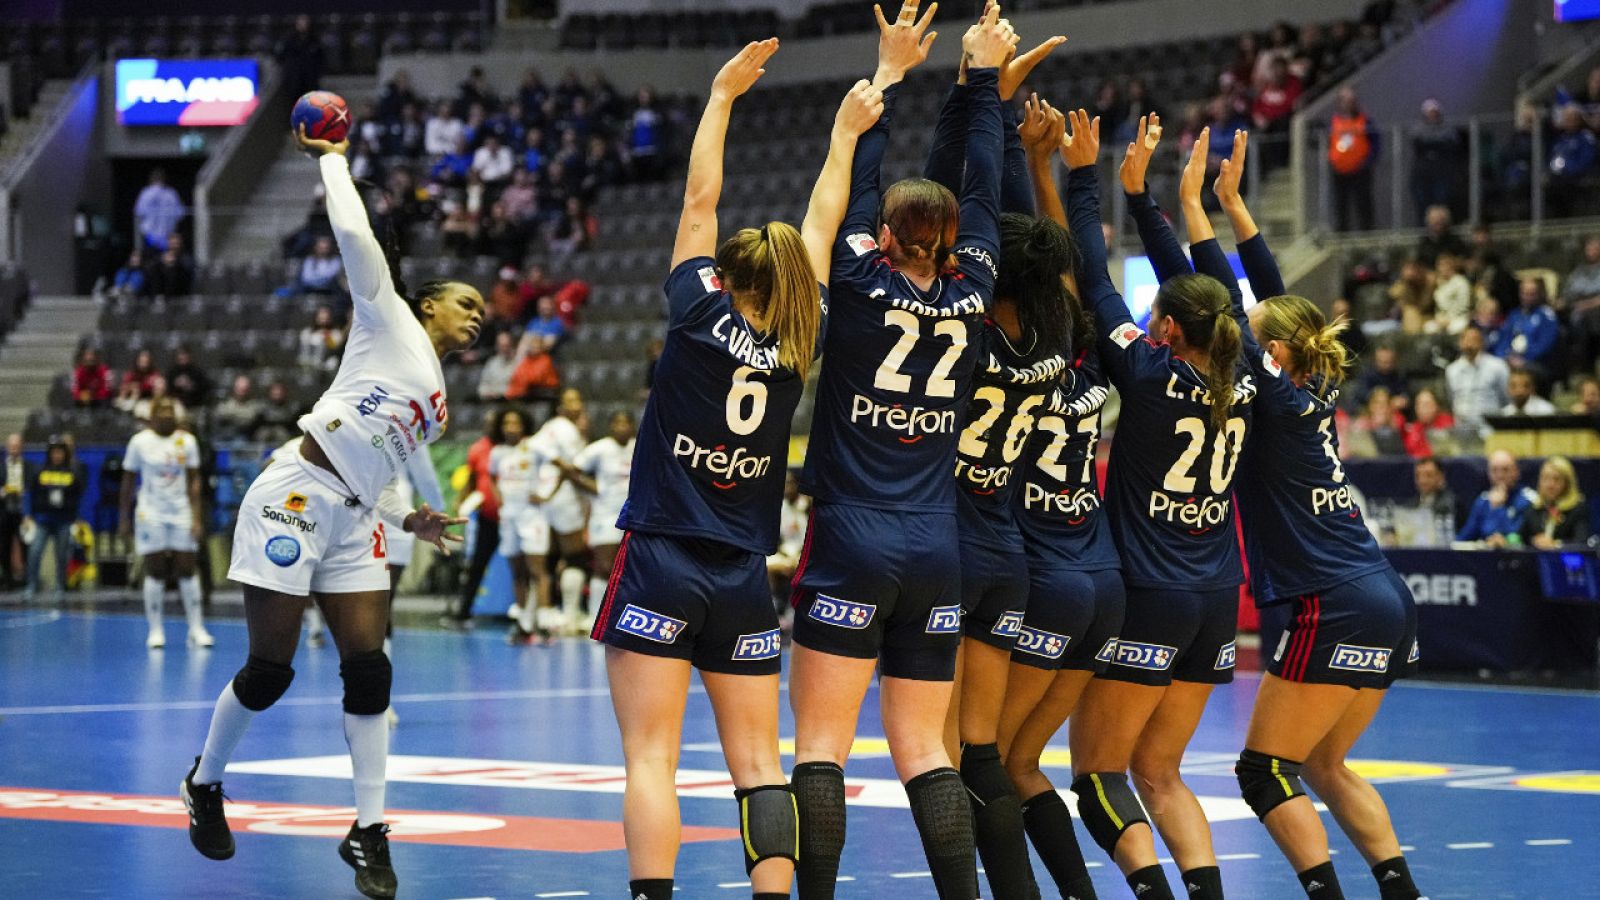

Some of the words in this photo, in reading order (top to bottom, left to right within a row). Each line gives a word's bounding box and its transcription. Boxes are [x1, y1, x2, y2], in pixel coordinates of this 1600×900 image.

[873, 309, 969, 398] 22
[725, 365, 770, 435] 6
[851, 394, 955, 436] Préfon
[957, 386, 1046, 464] 26
[673, 433, 771, 480] Préfon
[1036, 413, 1100, 484] 27
[1163, 417, 1246, 494] 20
[261, 505, 317, 534] Sonangol
[1402, 574, 1478, 606] GER
[620, 609, 661, 634] FDJ
[814, 598, 849, 621] FDJ
[738, 635, 771, 656] FDJ
[1117, 644, 1153, 665] FDJ
[1335, 649, 1373, 668] FDJ
